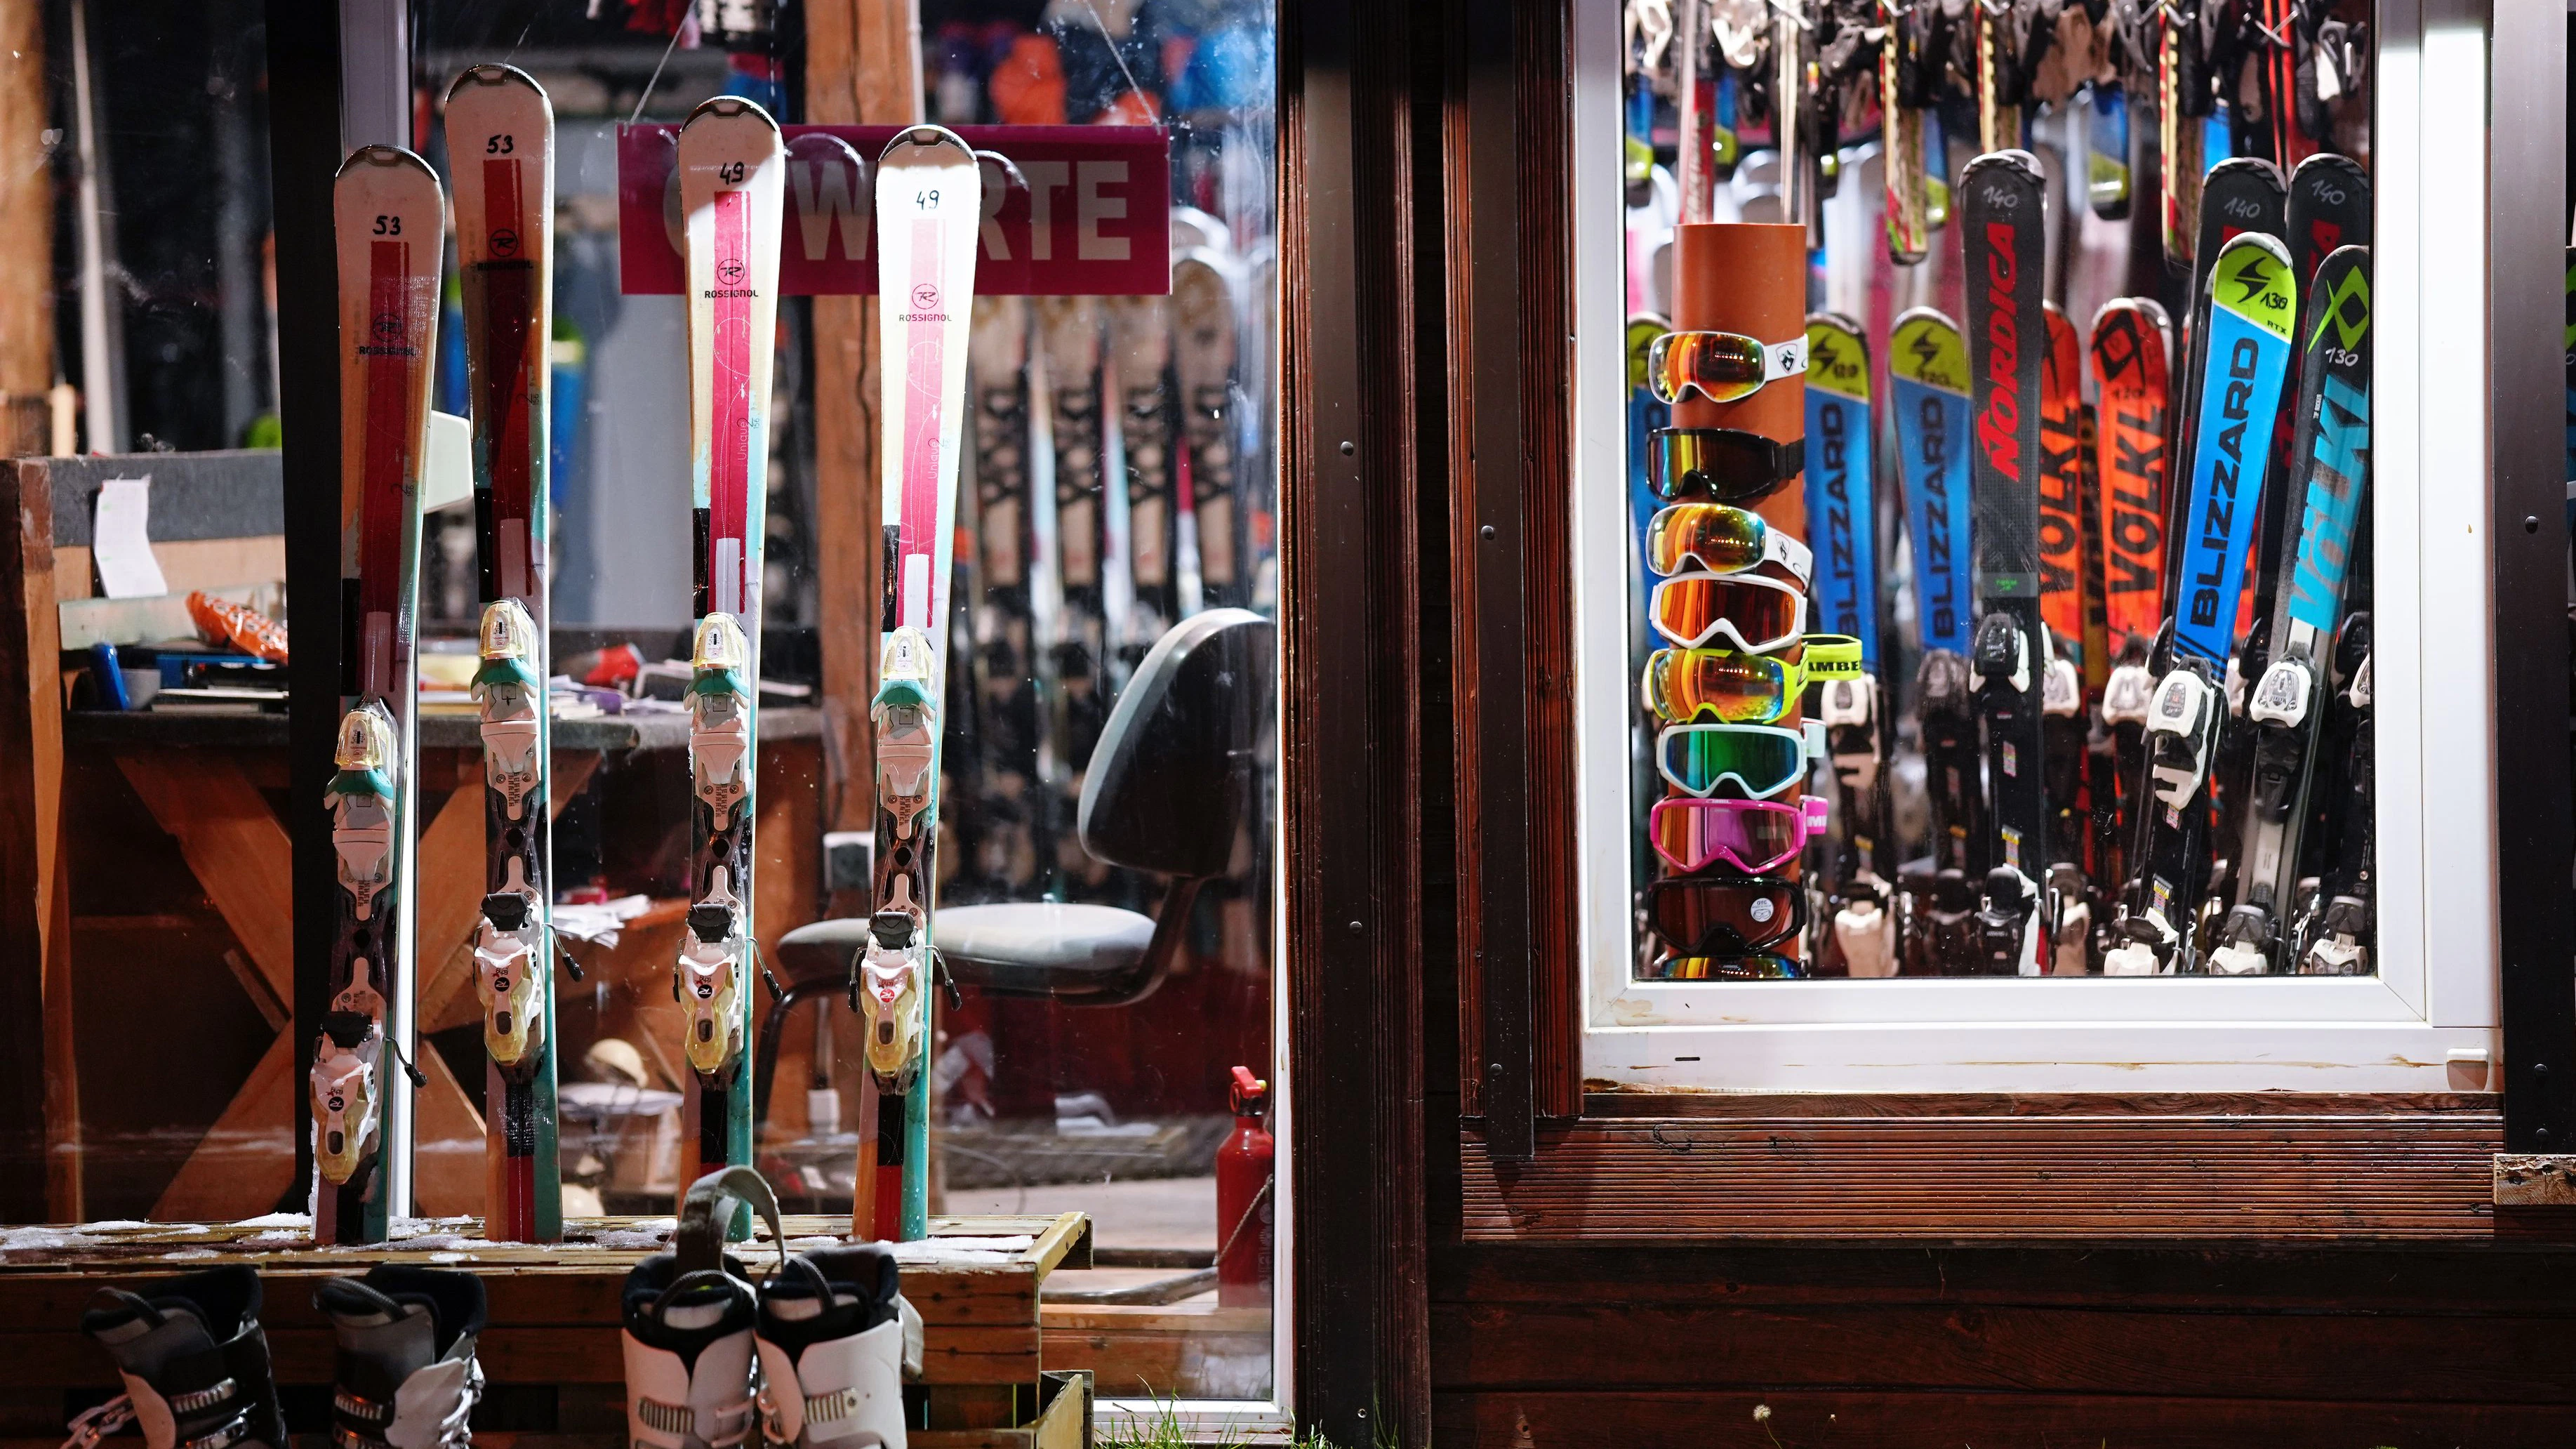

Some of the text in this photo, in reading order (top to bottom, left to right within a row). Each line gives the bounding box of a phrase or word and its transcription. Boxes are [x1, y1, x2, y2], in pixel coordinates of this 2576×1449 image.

[486, 134, 514, 154] 53
[719, 161, 745, 185] 49
[916, 190, 939, 211] 49
[1983, 185, 2018, 209] 140
[2312, 179, 2346, 205] 140
[2224, 197, 2261, 218] 140
[372, 215, 401, 235] 53
[704, 289, 759, 298] ROSSIGNOL
[2267, 319, 2287, 334] RTX
[1977, 222, 2019, 482] NORDICA
[2325, 347, 2358, 367] 130
[737, 421, 748, 461] Unique
[927, 440, 939, 479] Unique
[2189, 336, 2259, 628] BLIZZARD
[1918, 396, 1956, 638] BLIZZARD
